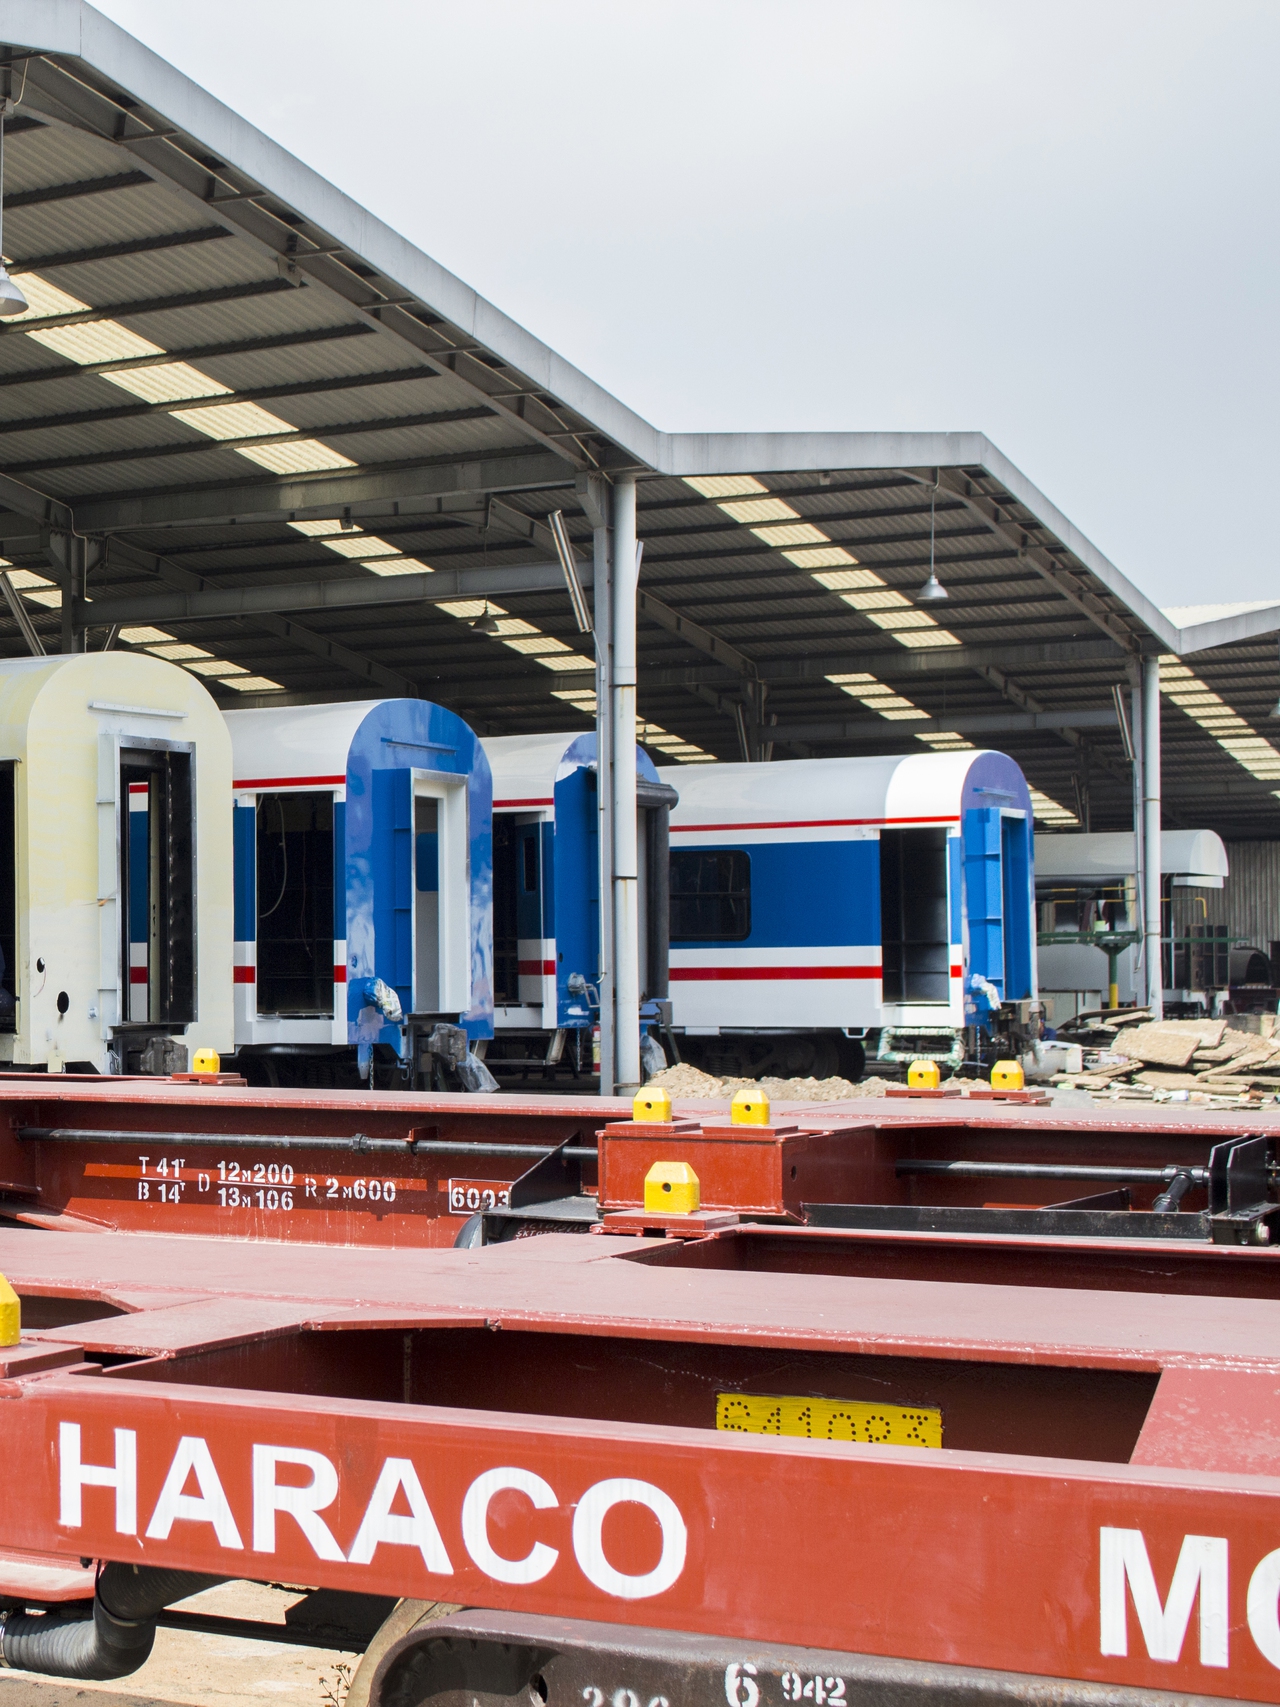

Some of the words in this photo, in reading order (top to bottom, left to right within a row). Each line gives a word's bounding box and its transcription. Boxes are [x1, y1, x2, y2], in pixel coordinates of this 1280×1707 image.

[138, 1156, 150, 1174] T
[138, 1182, 150, 1200] B
[305, 1177, 317, 1198] R
[59, 1421, 687, 1600] HARACO
[782, 1671, 847, 1707] 942
